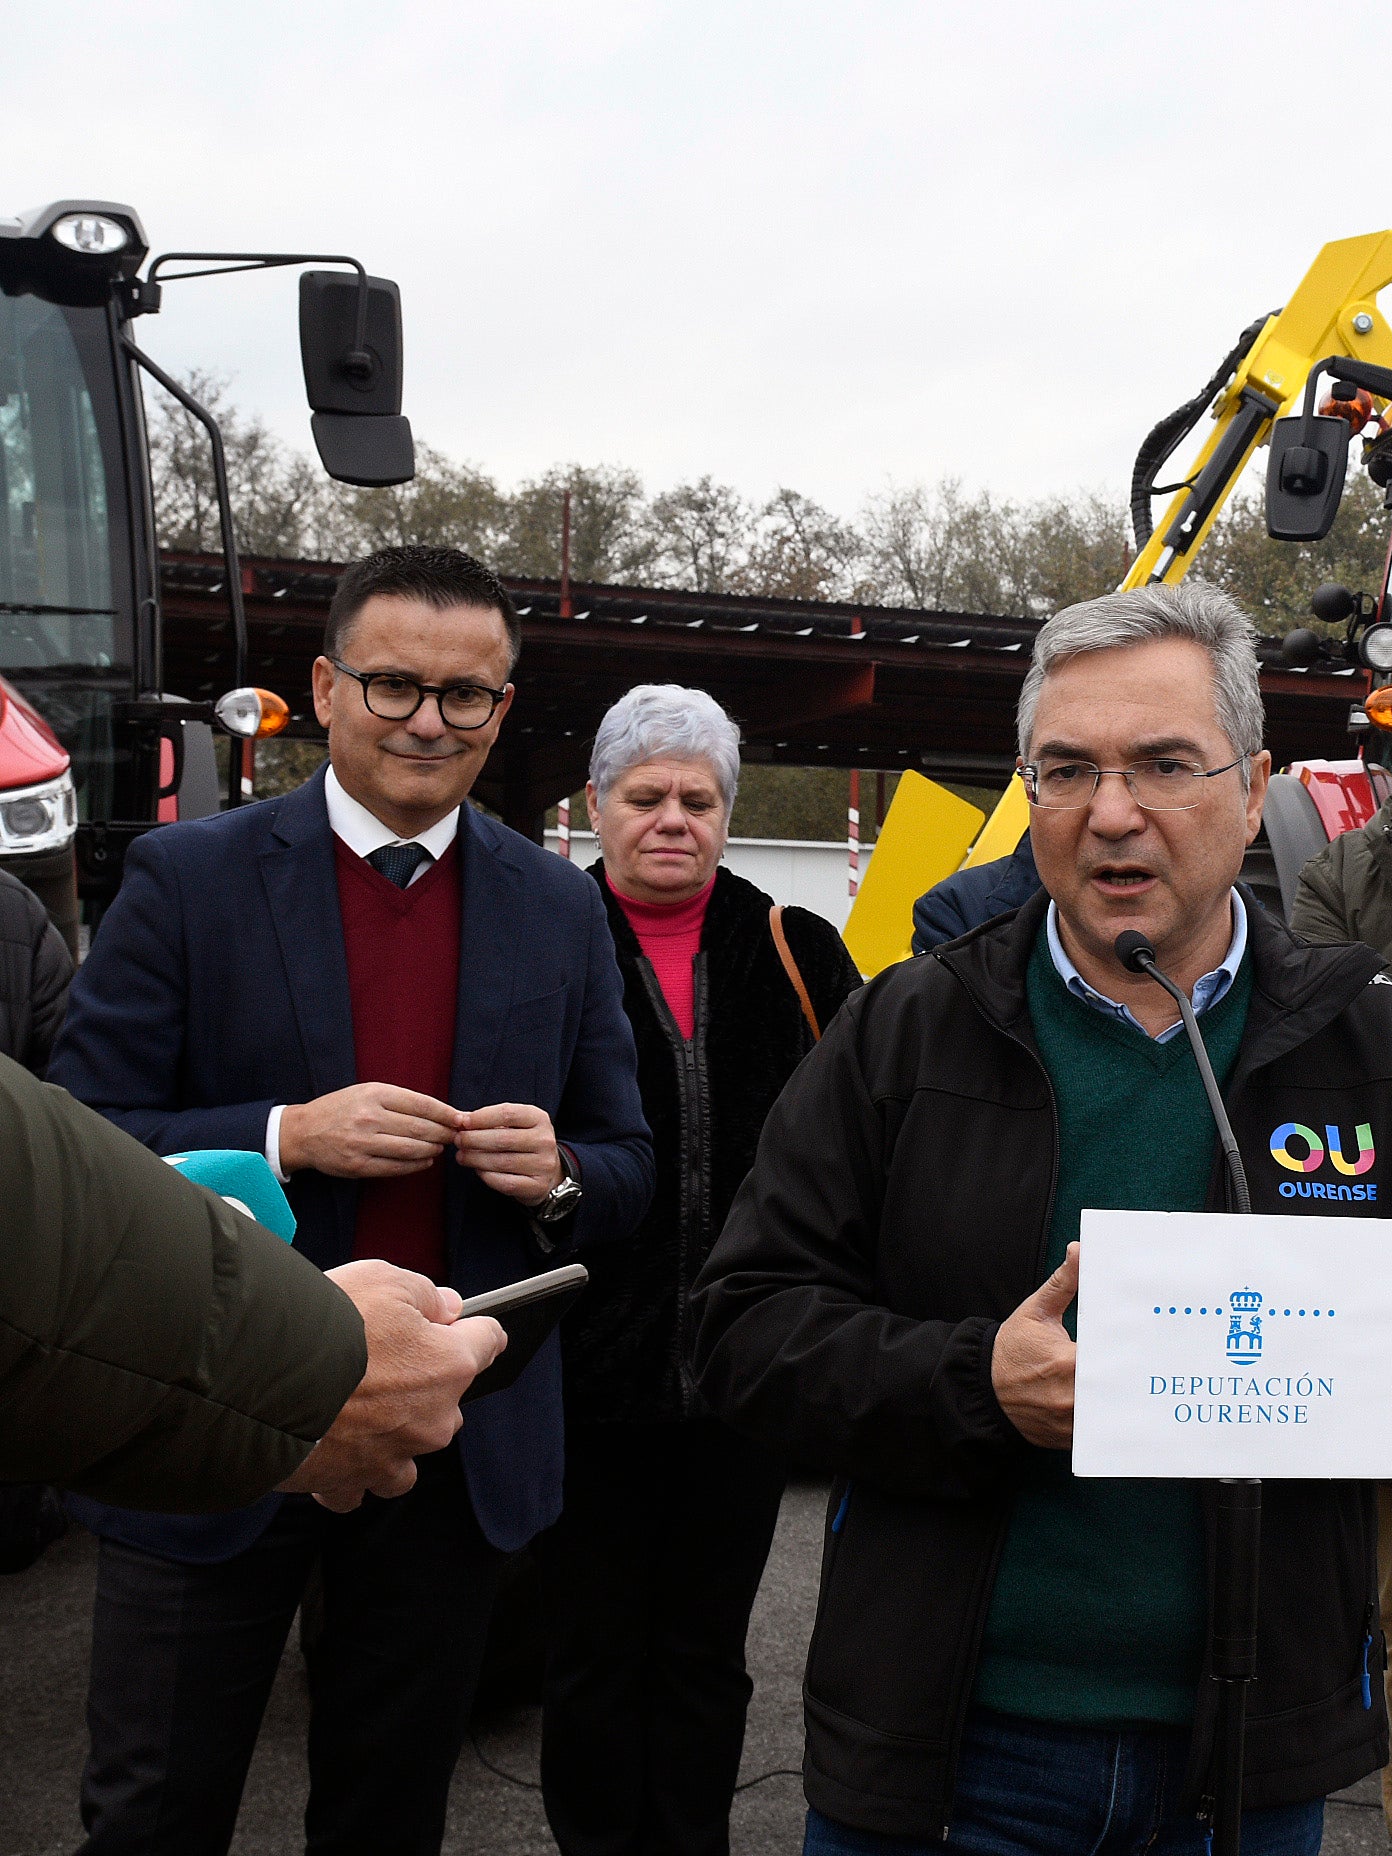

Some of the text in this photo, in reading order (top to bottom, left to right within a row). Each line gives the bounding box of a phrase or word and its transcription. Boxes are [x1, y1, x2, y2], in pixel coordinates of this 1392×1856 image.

[1270, 1123, 1375, 1175] OU
[1149, 1373, 1334, 1397] DEPUTACIÓN
[1174, 1403, 1308, 1424] OURENSE
